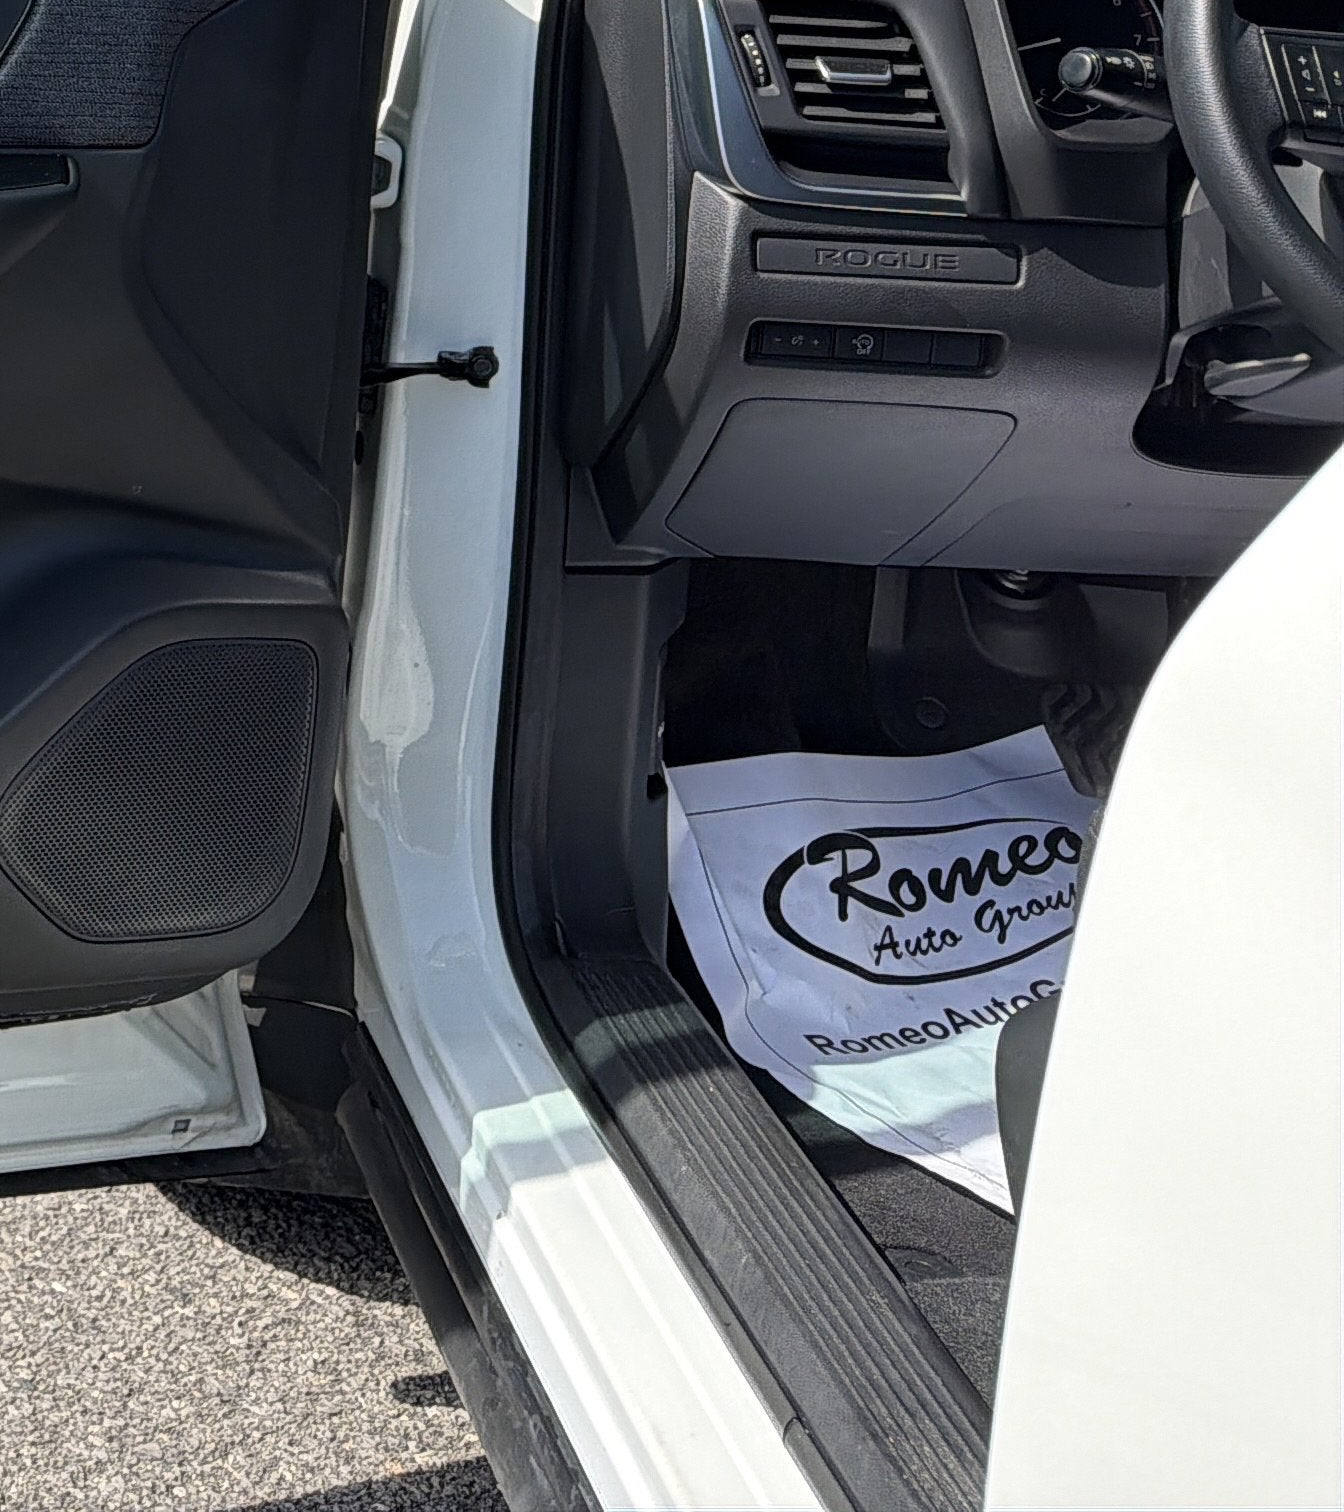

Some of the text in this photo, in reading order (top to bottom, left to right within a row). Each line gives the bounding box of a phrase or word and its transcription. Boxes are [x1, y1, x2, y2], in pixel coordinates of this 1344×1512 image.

[1133, 34, 1142, 46] 7
[814, 247, 961, 272] ROGUE
[806, 826, 1083, 922] Romeo
[874, 882, 1076, 966] Auto Grou
